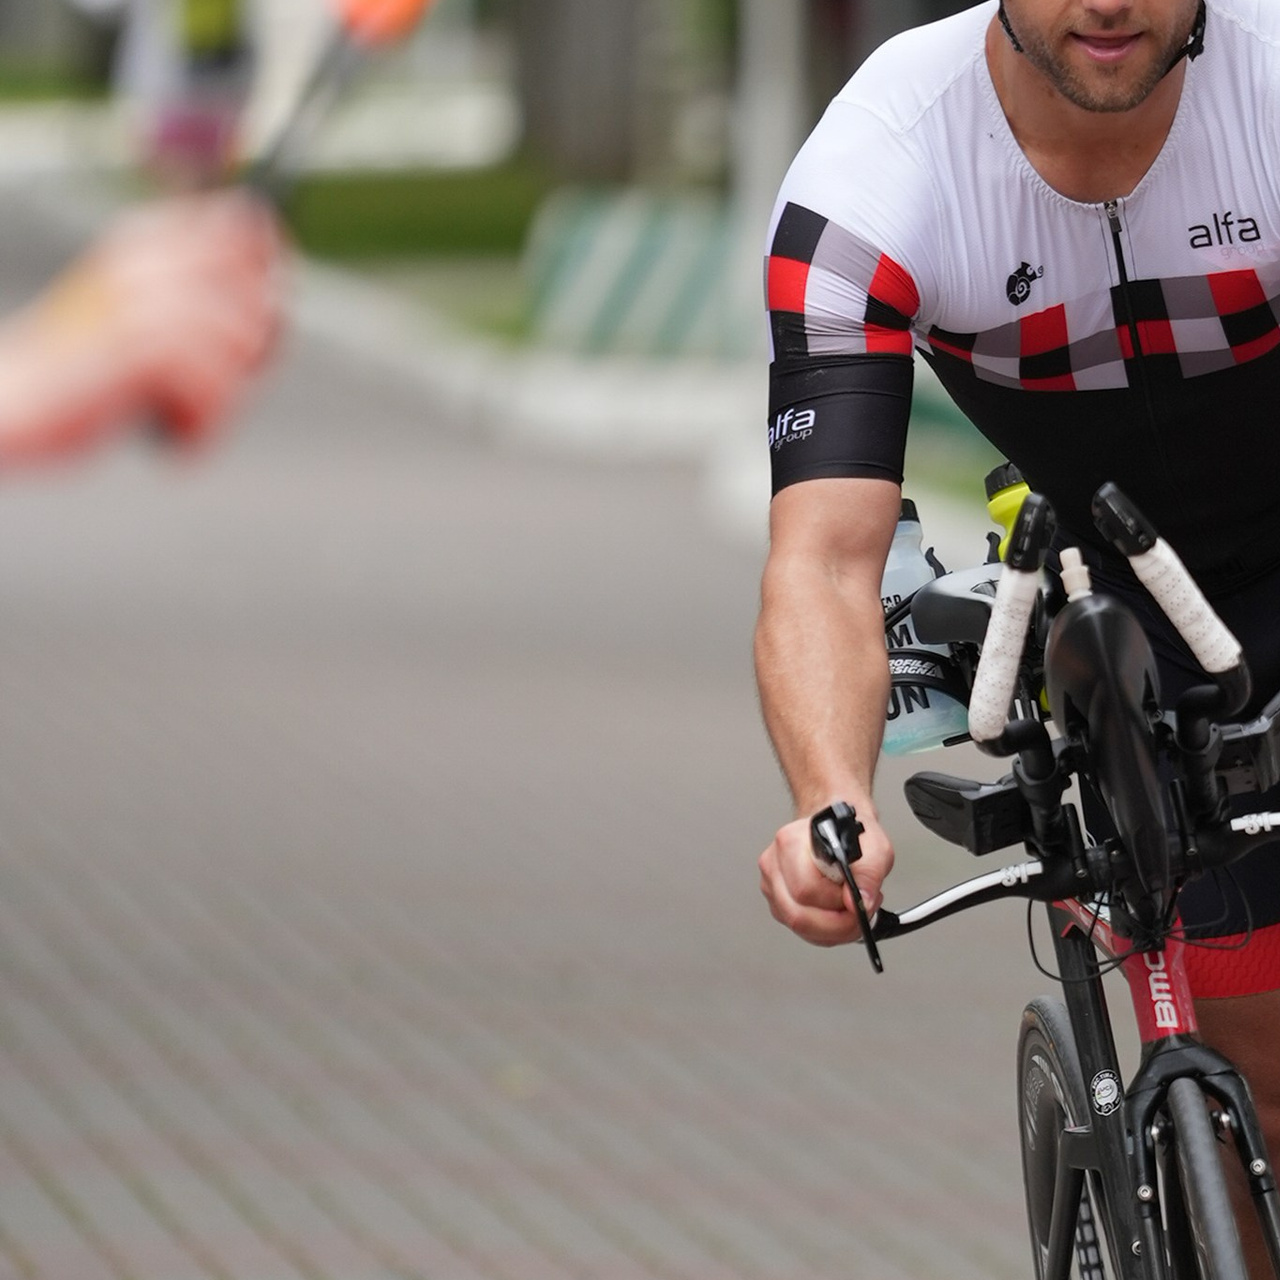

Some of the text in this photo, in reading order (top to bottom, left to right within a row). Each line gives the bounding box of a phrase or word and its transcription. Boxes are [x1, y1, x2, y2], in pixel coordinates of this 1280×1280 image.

[1188, 211, 1261, 249] alfa
[774, 428, 813, 452] group
[1143, 951, 1179, 1028] BMC
